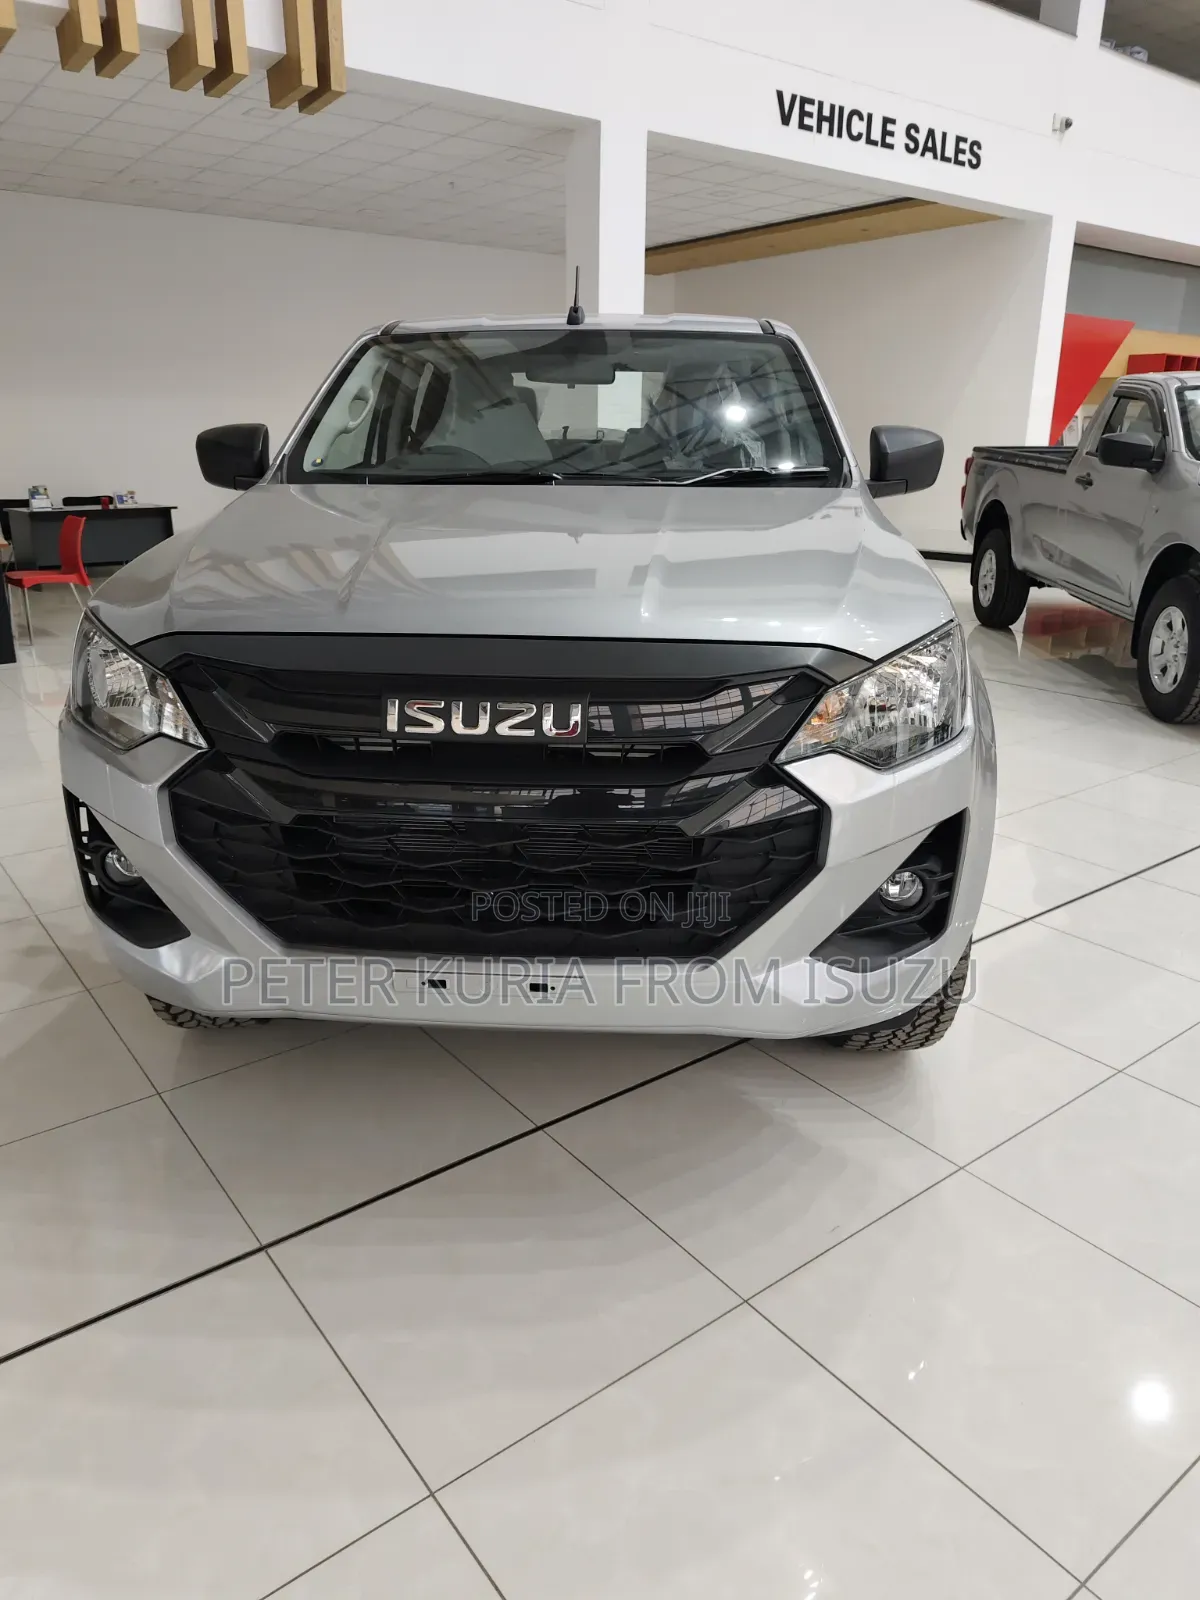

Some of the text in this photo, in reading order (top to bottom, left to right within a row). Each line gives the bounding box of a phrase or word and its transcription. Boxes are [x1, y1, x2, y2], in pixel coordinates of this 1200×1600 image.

[776, 89, 982, 170] VEHICLE SALES
[386, 698, 582, 737] ISUZU
